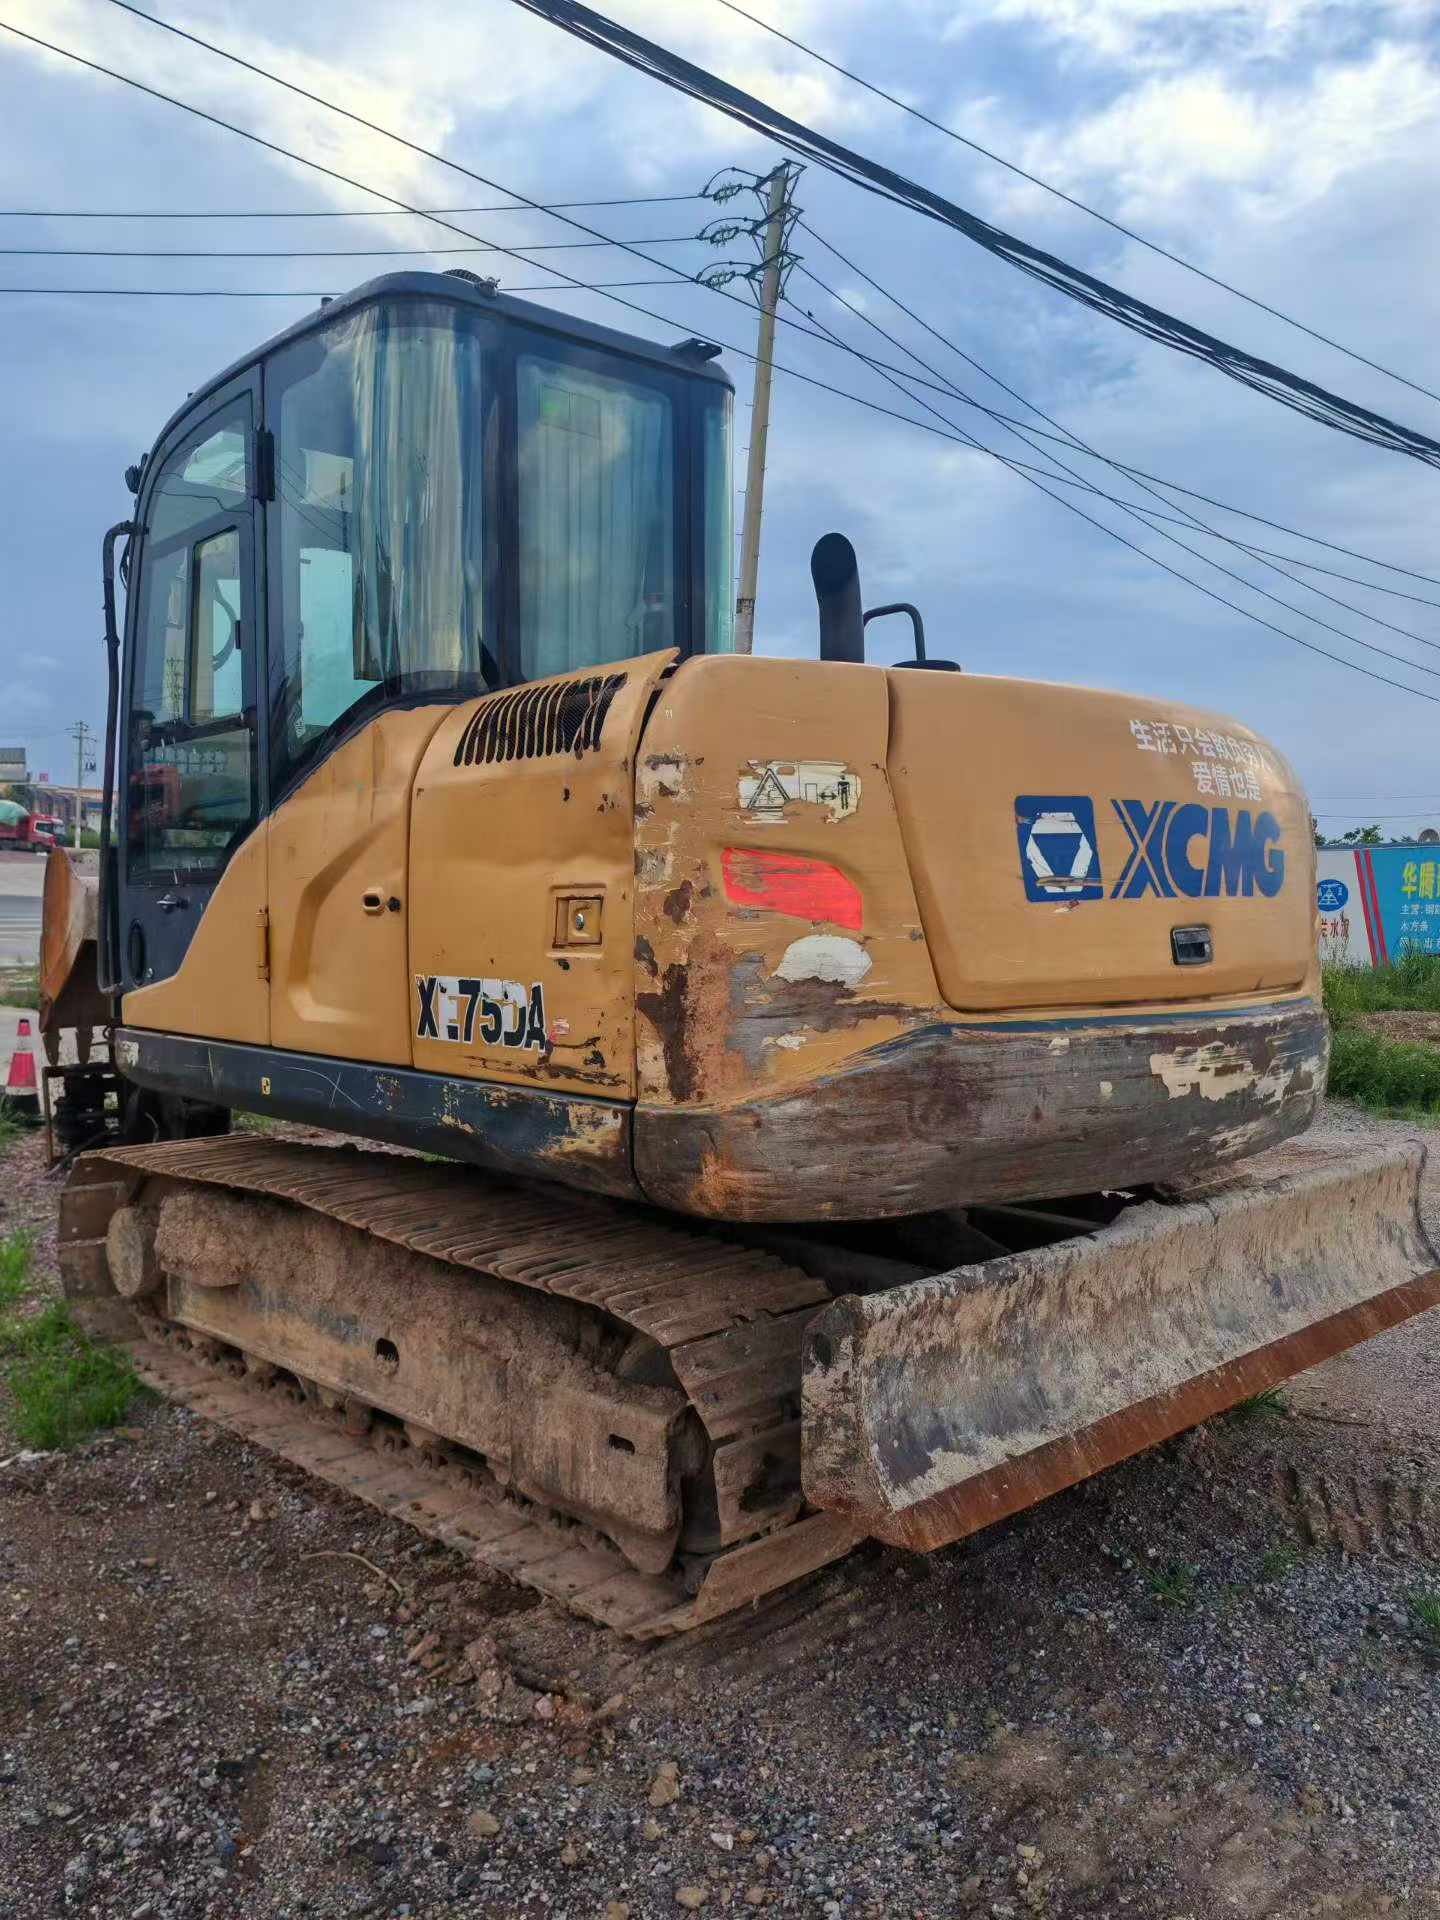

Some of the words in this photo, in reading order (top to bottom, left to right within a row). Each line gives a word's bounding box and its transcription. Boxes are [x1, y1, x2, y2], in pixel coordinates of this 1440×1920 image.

[1192, 761, 1261, 800] 爱情也是
[1110, 799, 1285, 899] XCMG
